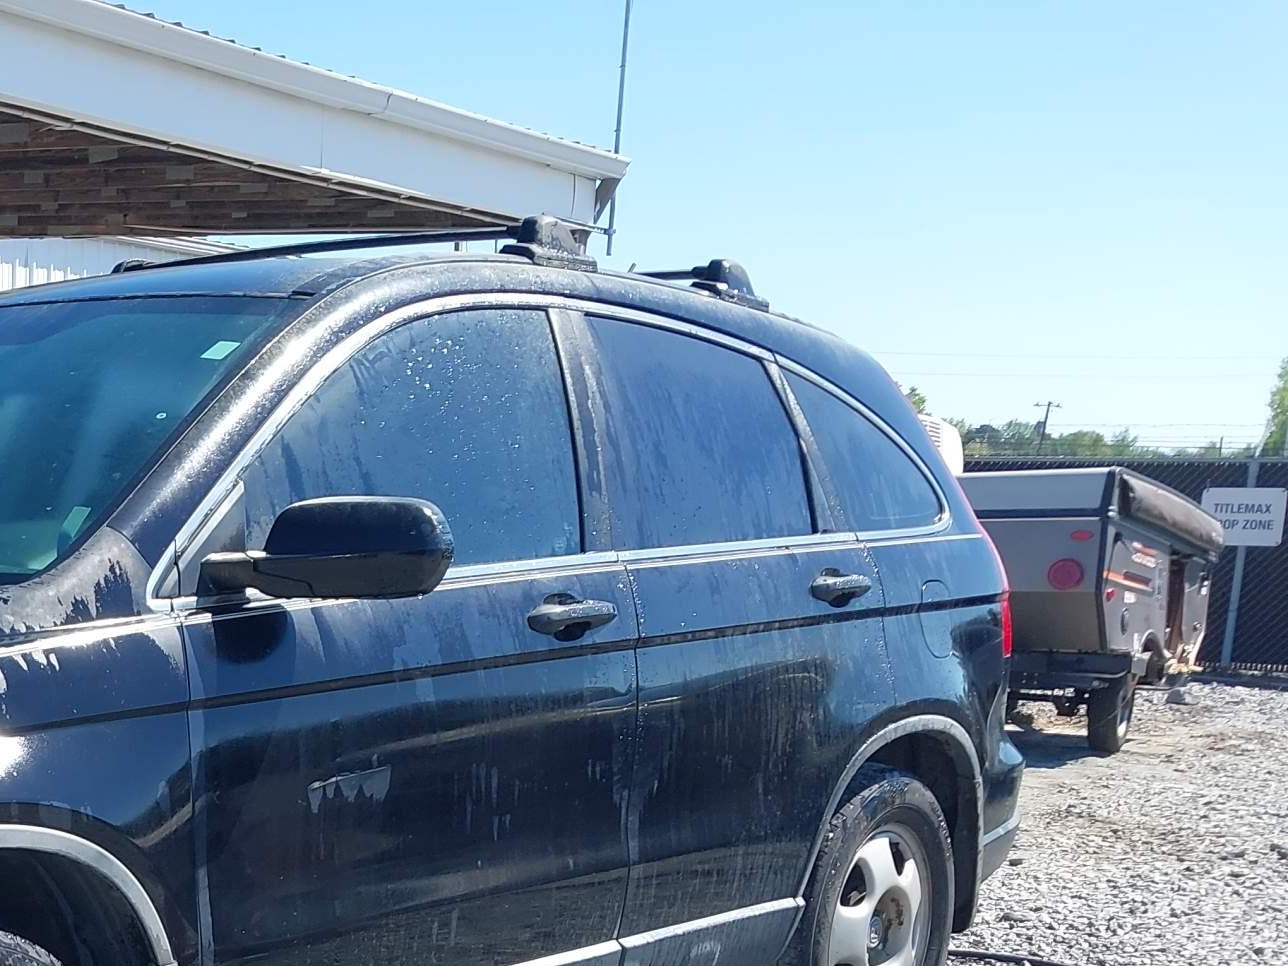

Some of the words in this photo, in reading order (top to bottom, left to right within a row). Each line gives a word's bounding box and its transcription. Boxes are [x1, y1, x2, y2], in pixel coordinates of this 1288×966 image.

[1214, 503, 1272, 514] TITLEMAX
[1219, 519, 1239, 530] OP
[1242, 519, 1274, 530] ZONE
